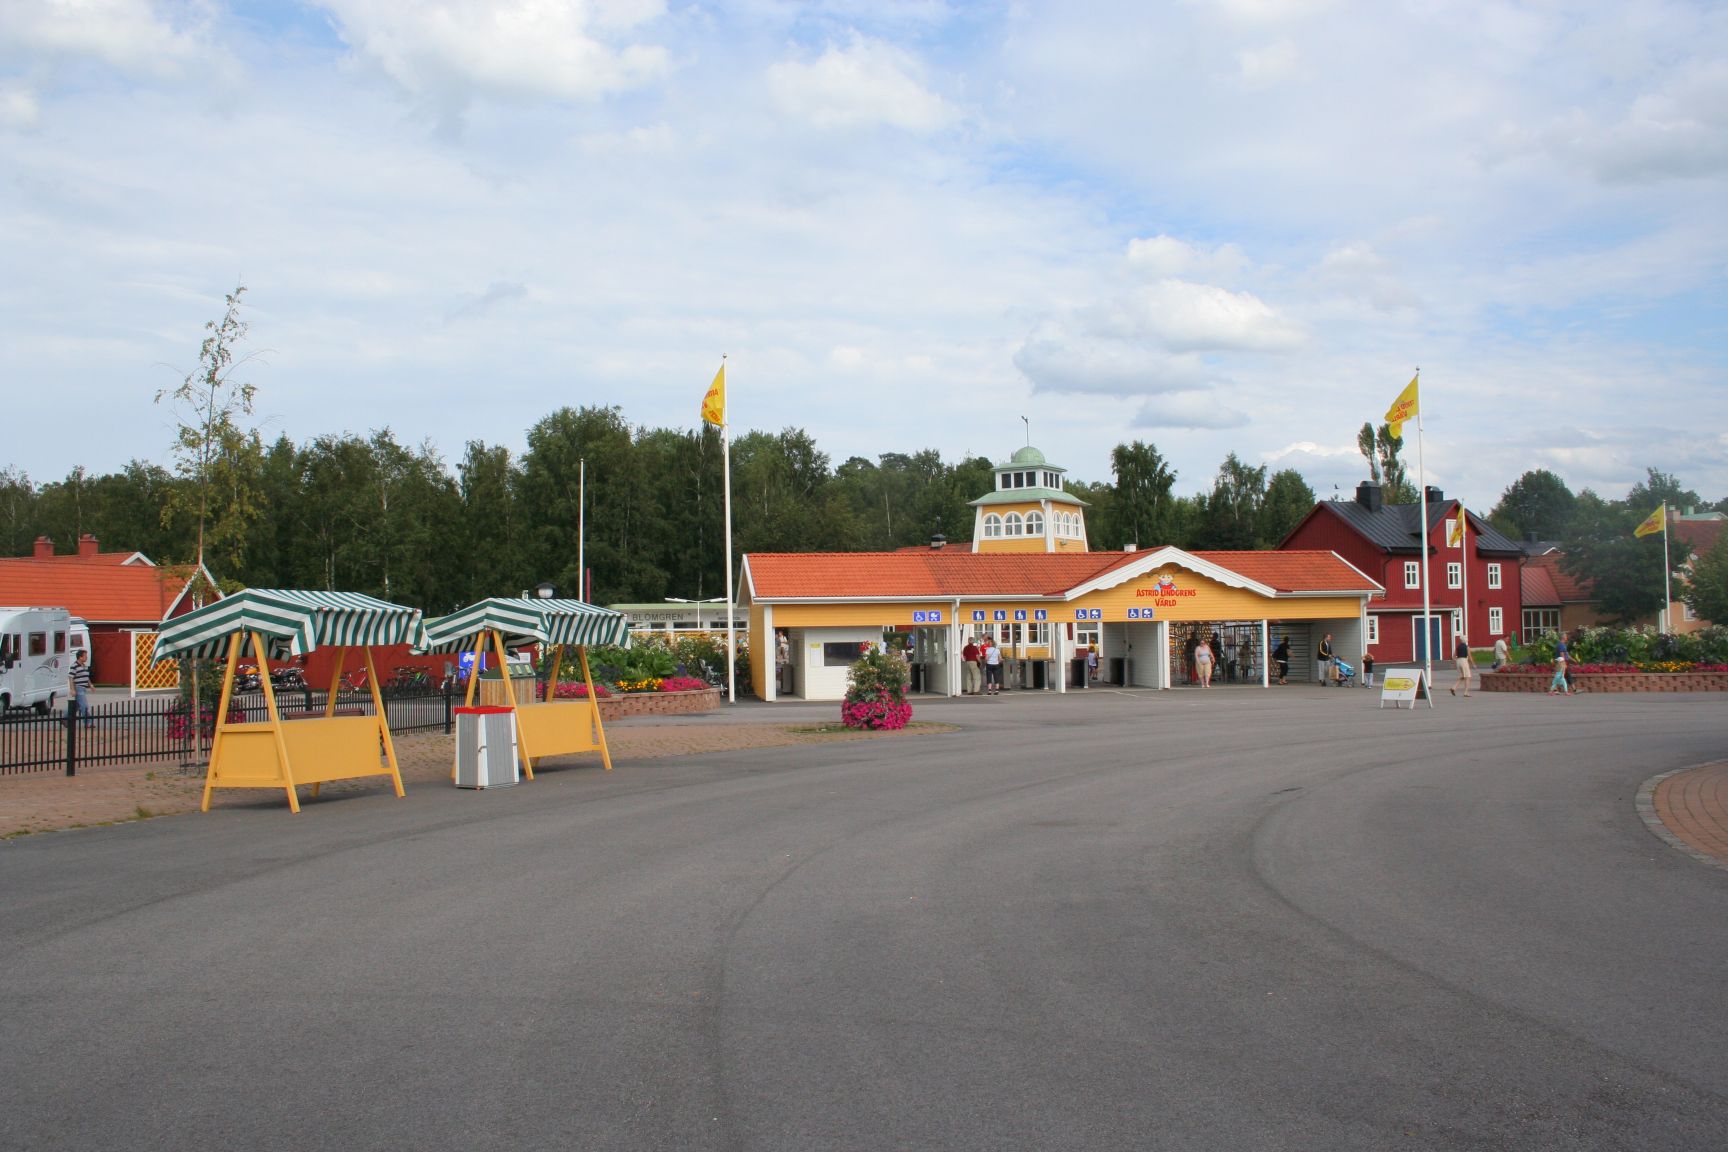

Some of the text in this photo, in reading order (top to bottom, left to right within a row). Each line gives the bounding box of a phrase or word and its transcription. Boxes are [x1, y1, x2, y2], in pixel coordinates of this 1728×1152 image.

[1136, 589, 1196, 597] ASTRID LINDGRENS
[1155, 598, 1177, 607] VÄRLD
[632, 613, 684, 621] BLOMGREN
